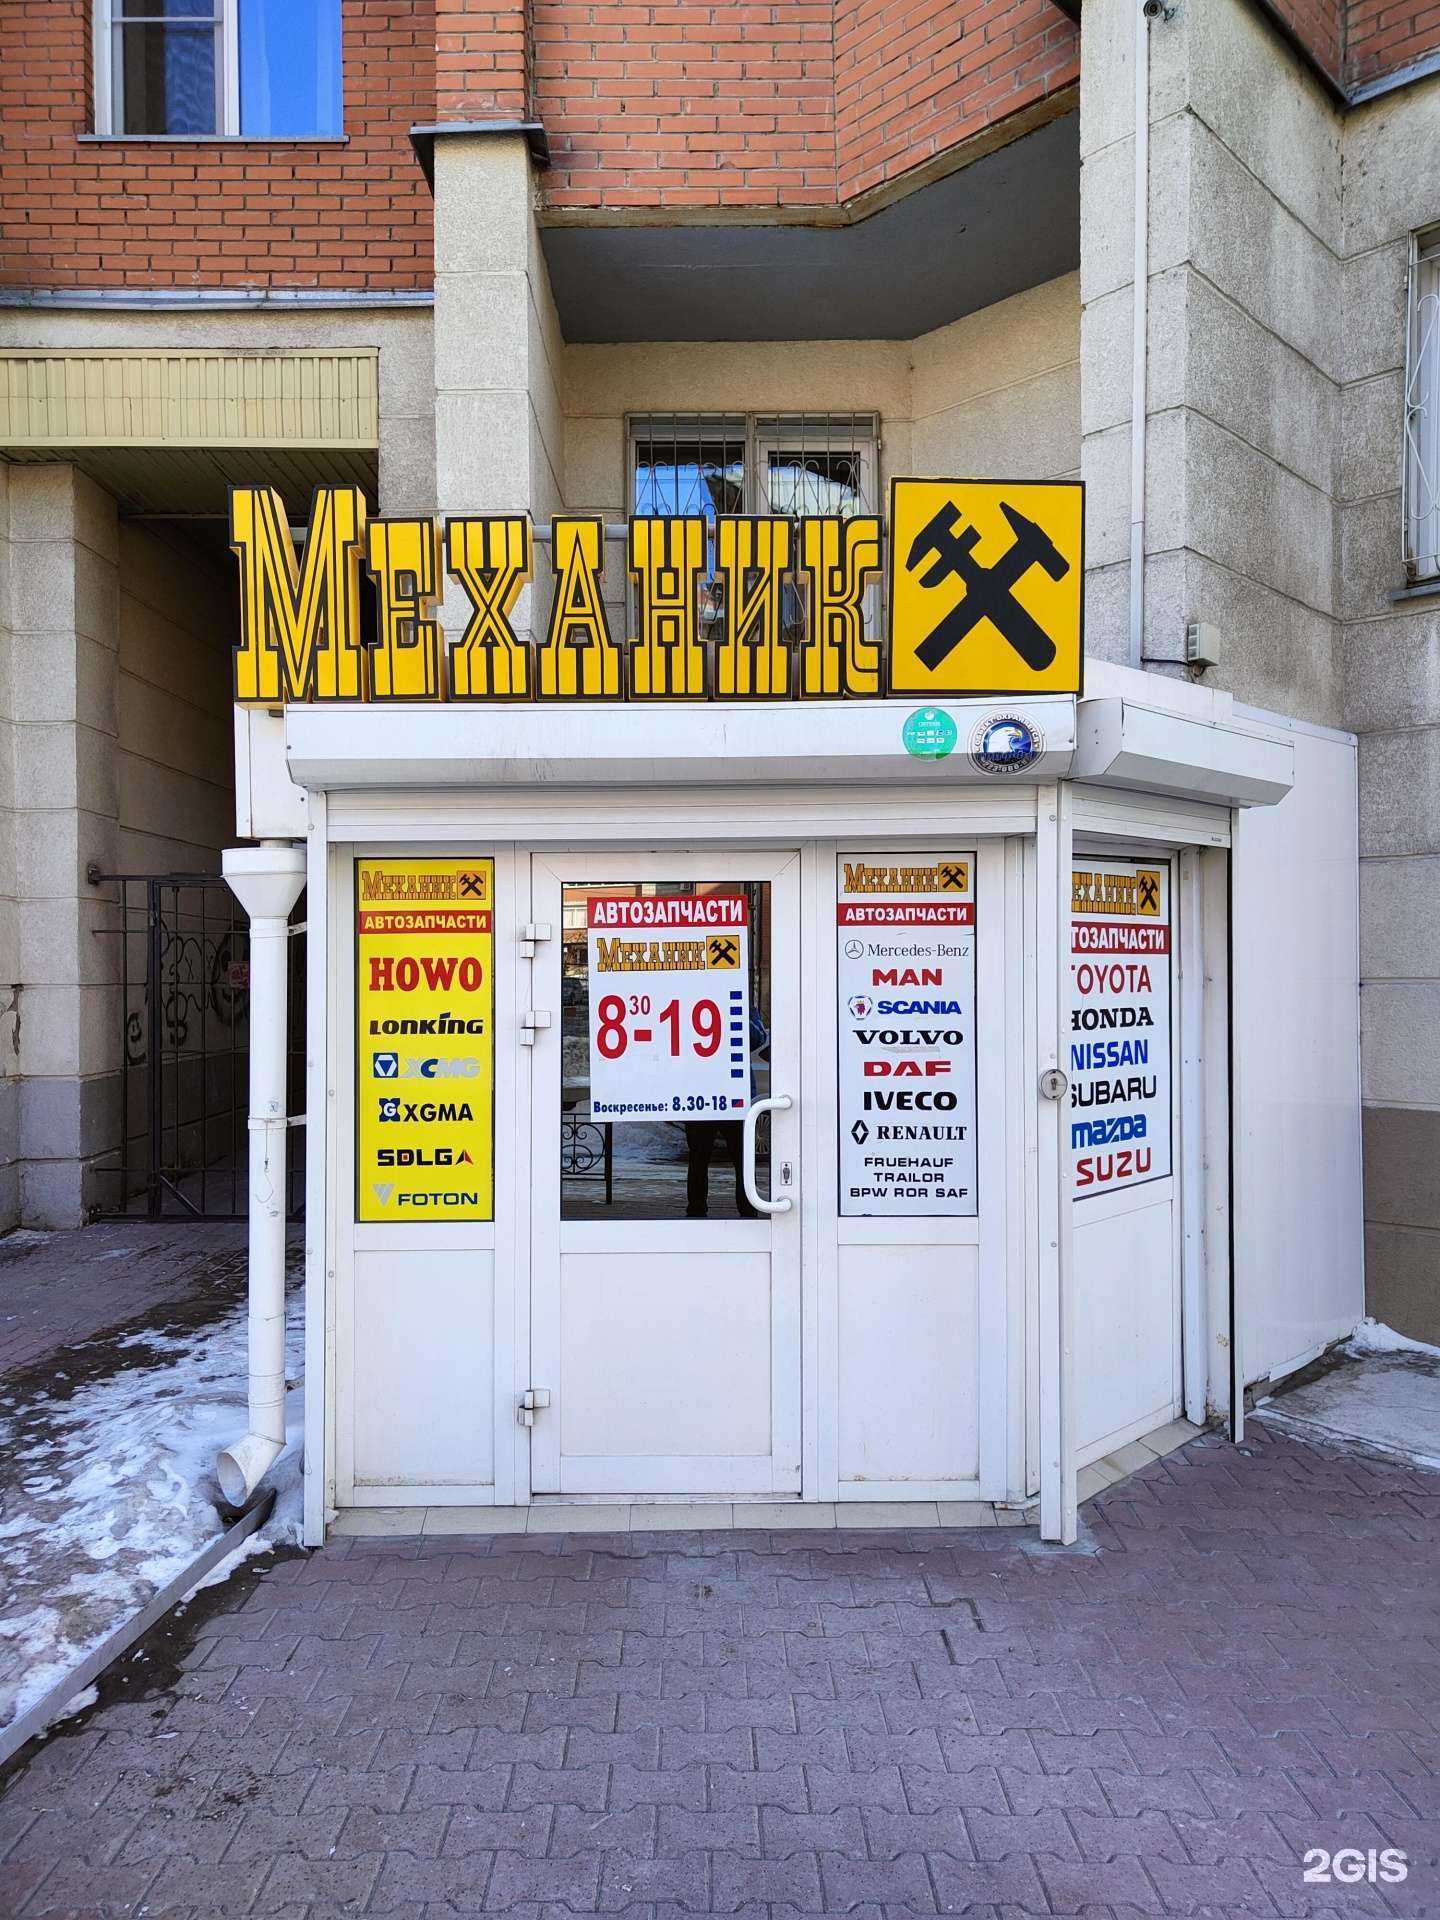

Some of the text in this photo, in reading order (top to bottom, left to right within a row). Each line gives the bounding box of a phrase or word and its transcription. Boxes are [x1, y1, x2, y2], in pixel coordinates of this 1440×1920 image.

[593, 899, 743, 925] АВТОЗАПЧАСТИ
[845, 906, 968, 922] АВТОЗАПЧАСТИ
[364, 915, 487, 930] АВТОЗАПЧАСТИ
[868, 943, 969, 958] Mercedes-Benz
[368, 956, 483, 992] HOWO
[872, 968, 943, 987] MAN
[1071, 963, 1152, 995] OYOTA
[877, 1000, 962, 1015] SCANIA
[852, 1029, 964, 1045] VOLVO
[1071, 1038, 1149, 1072] NISSAN
[401, 1057, 480, 1078] XCMG
[864, 1060, 952, 1077] DAF
[593, 1095, 728, 1114] Воскресенье: 8.30-18
[863, 1091, 958, 1111] IVECO
[403, 1102, 474, 1122] XGMA
[876, 1125, 968, 1141] RENAULT
[377, 1148, 453, 1167] SDLG
[864, 1156, 955, 1168] FRUEHAUF
[873, 1171, 945, 1183] TRAILOR
[398, 1192, 479, 1207] FOTON
[850, 1187, 969, 1199] BPW ROR SAF
